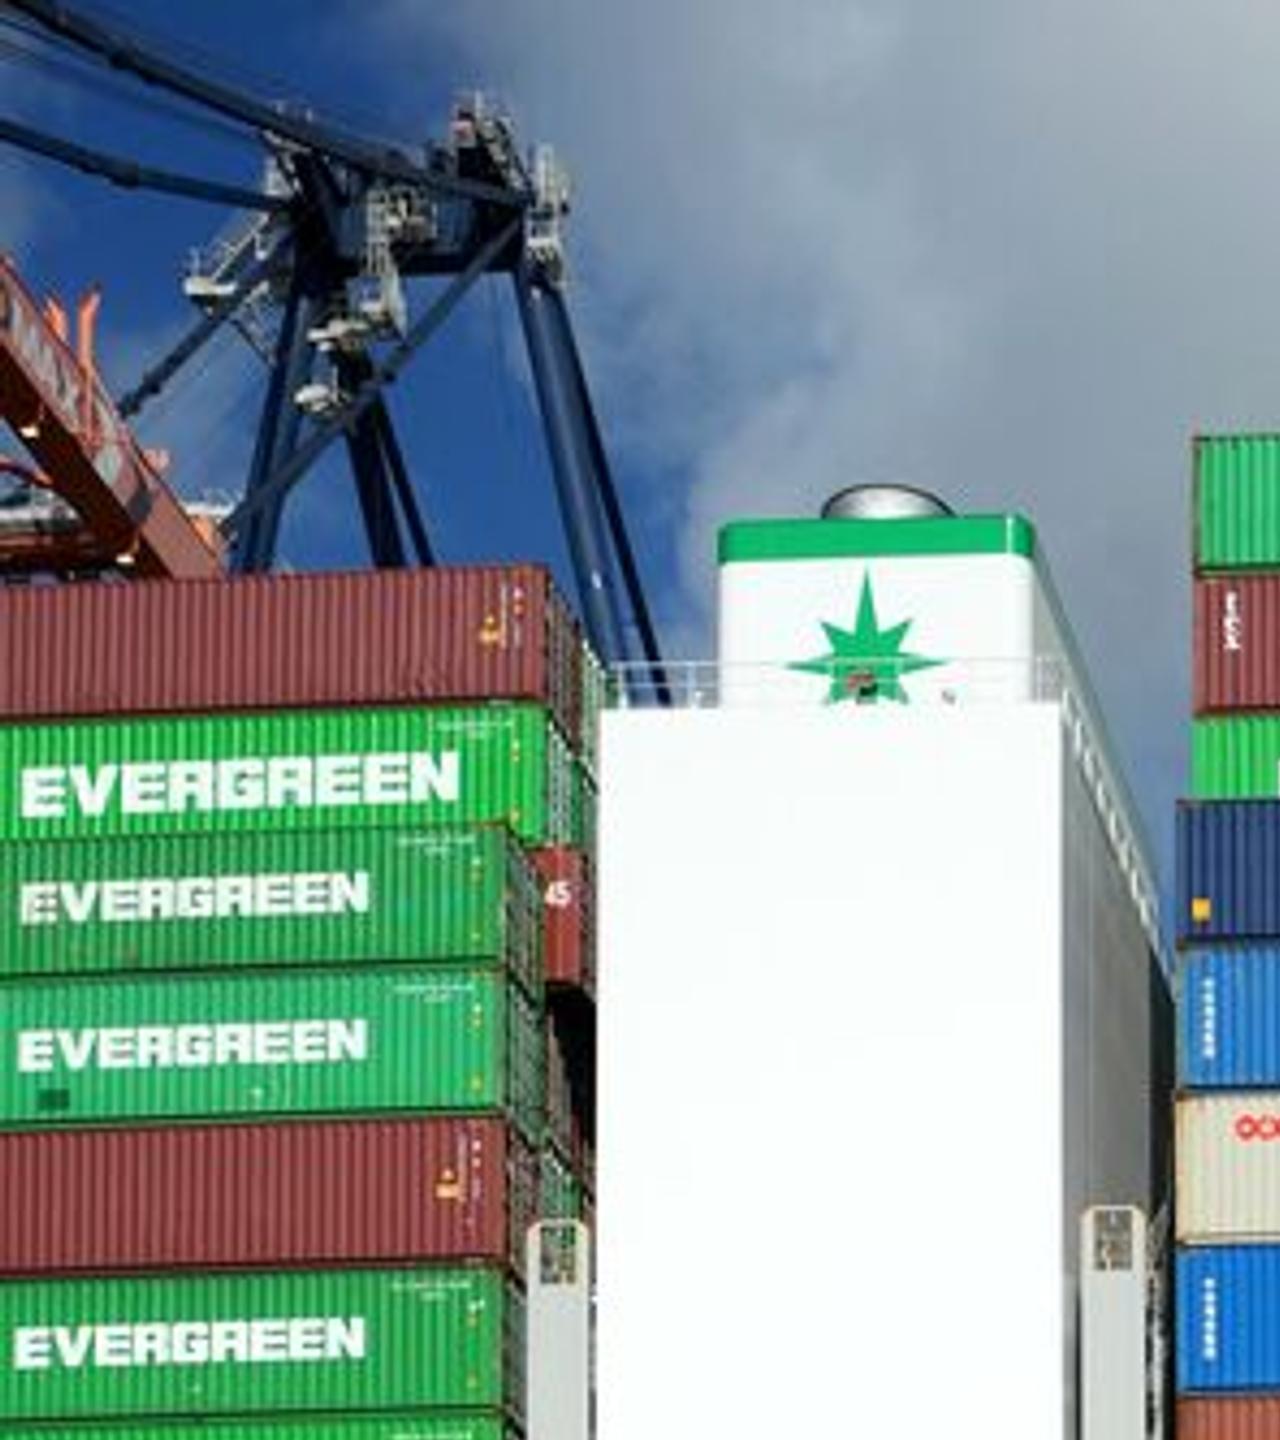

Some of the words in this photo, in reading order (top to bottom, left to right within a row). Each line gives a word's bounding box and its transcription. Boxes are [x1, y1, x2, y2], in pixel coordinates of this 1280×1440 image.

[22, 752, 459, 817] EVERGREEN
[21, 872, 368, 923] EVERGREEN
[19, 1019, 366, 1071] EVERGREEN
[15, 1317, 364, 1367] EVERGREEN
